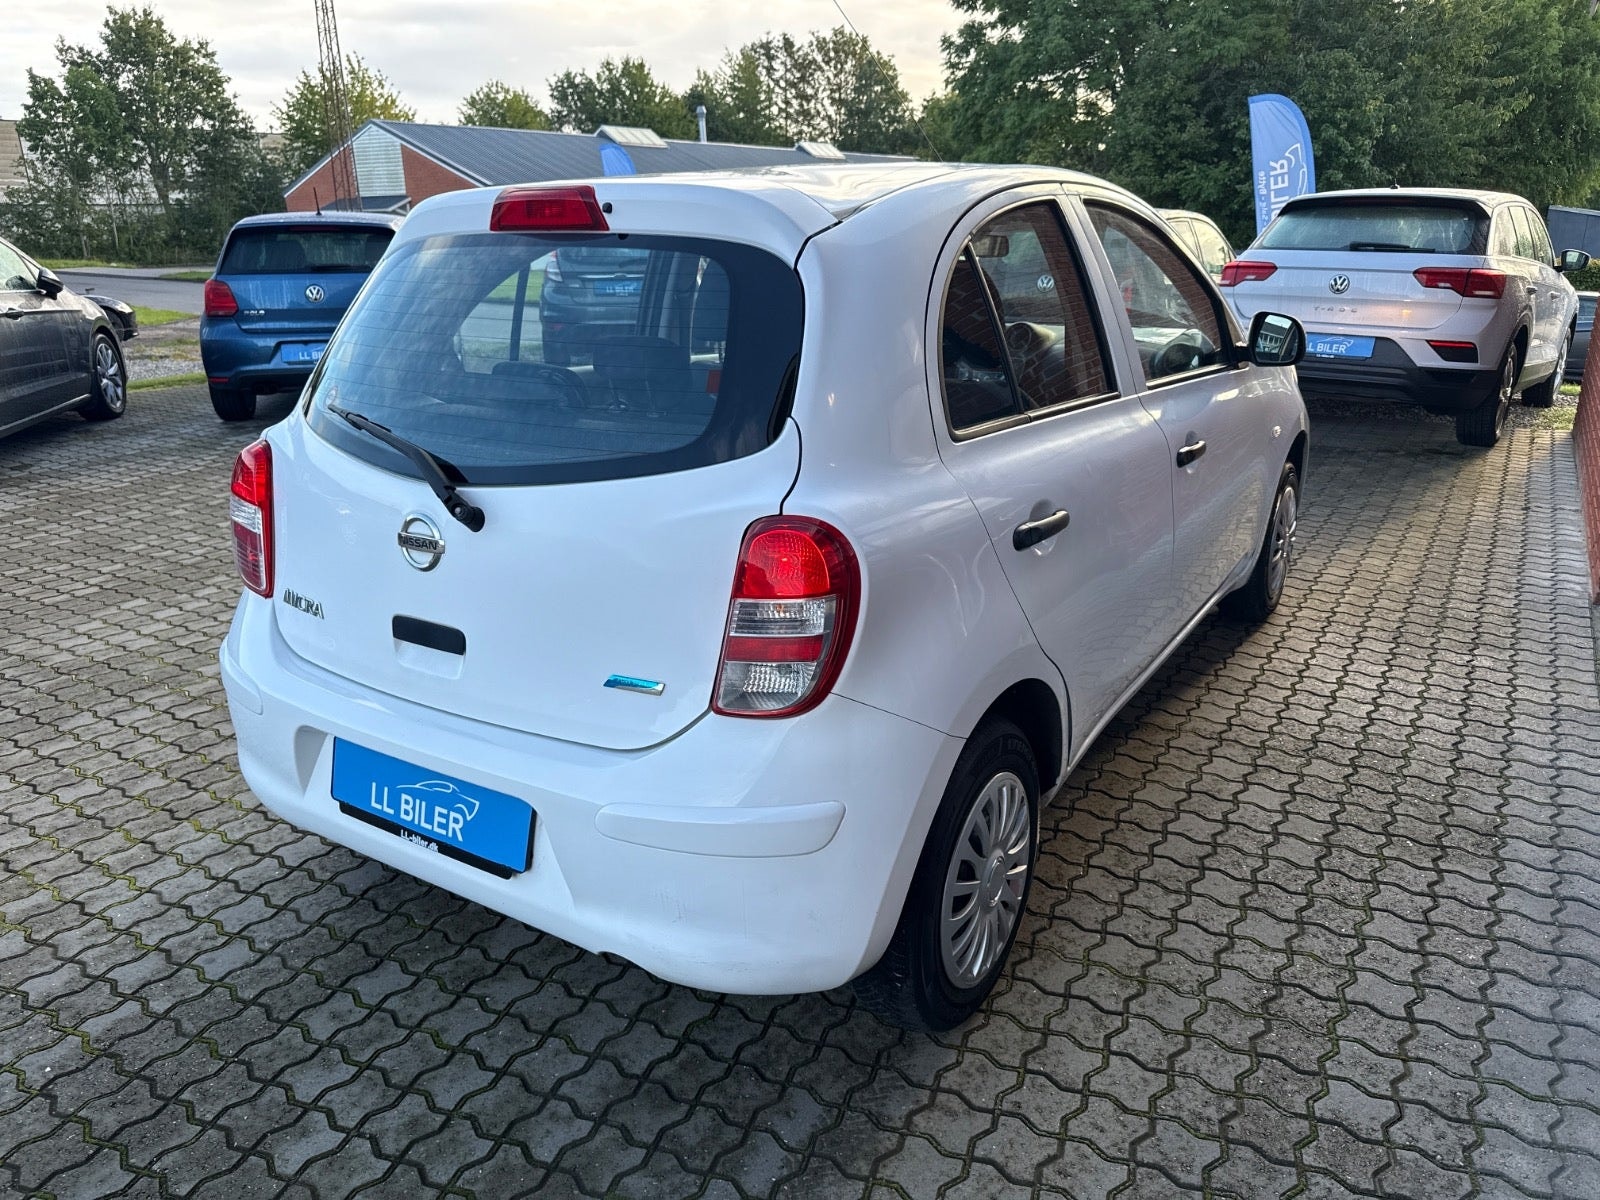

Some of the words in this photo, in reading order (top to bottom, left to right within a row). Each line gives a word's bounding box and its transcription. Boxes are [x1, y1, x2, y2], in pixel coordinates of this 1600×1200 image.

[299, 351, 310, 360] LL
[1316, 343, 1346, 353] BILER
[403, 535, 437, 550] NISSAN
[283, 588, 325, 619] MICRA
[371, 782, 394, 815] LL
[400, 793, 464, 842] BILER
[400, 829, 439, 853] LL-biler.dk
